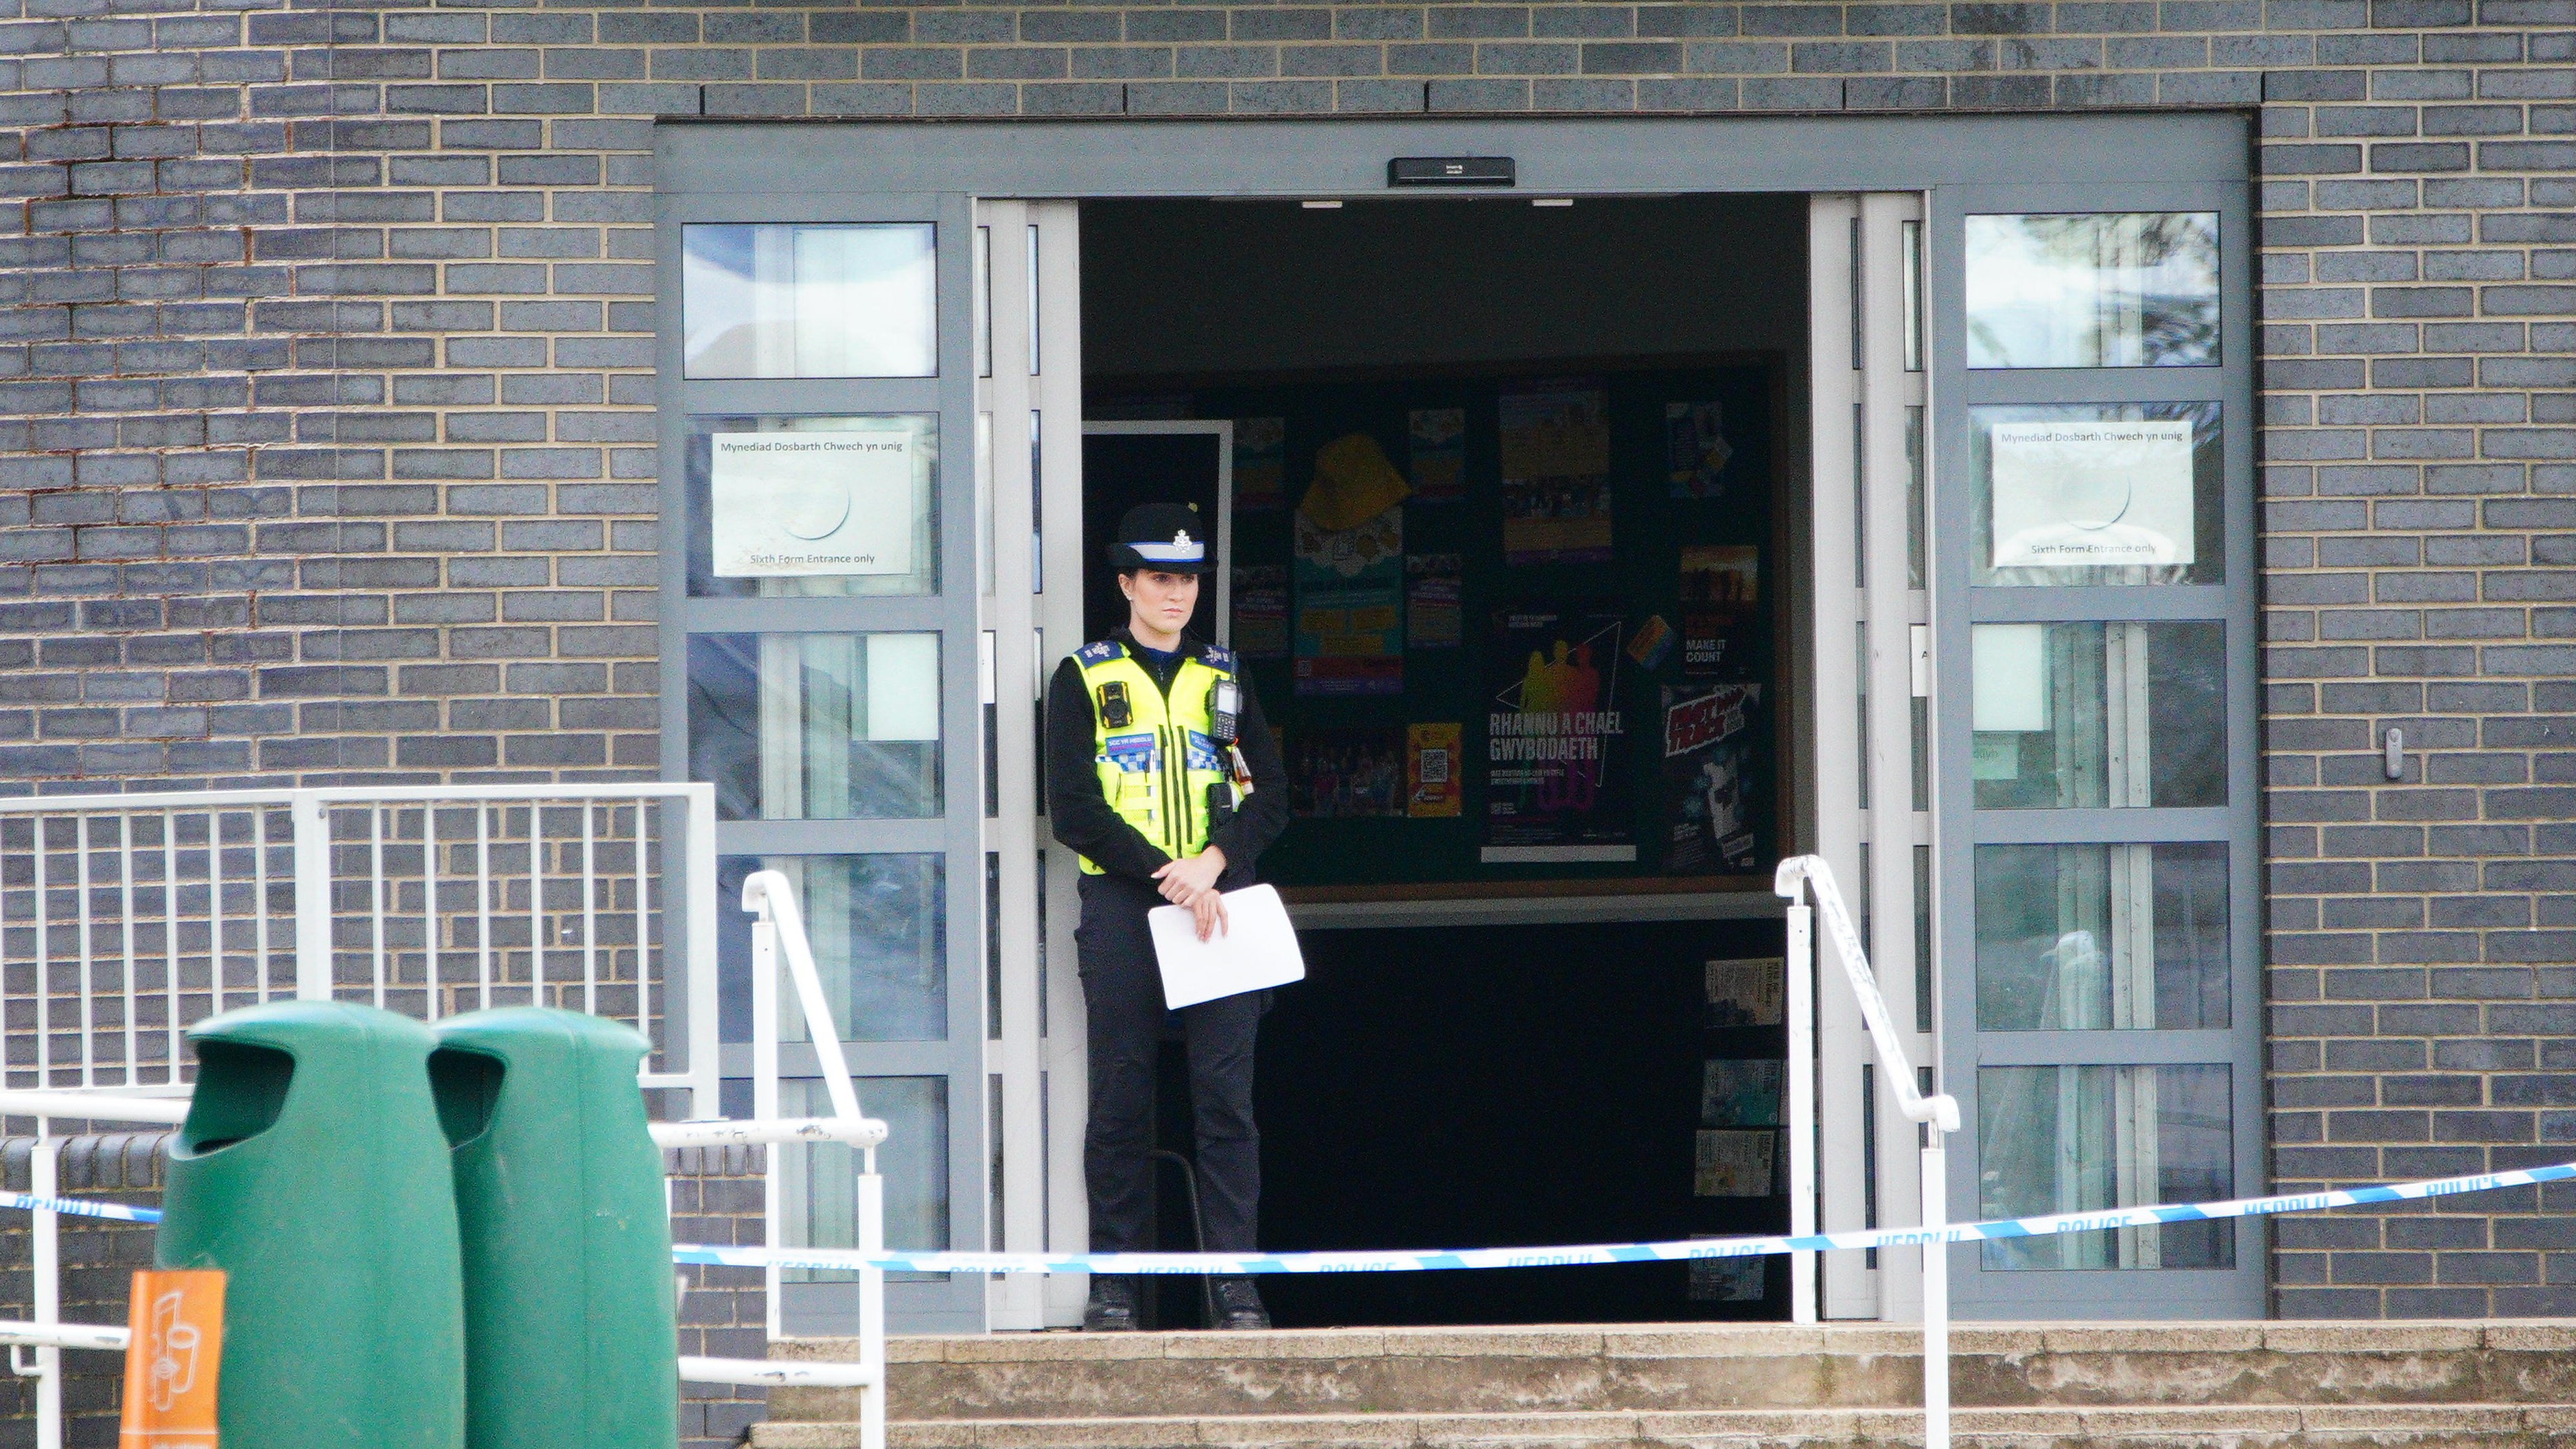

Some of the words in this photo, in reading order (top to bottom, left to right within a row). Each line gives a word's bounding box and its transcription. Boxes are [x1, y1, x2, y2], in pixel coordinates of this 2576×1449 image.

[2001, 433, 2052, 443] Mynediad
[2055, 432, 2101, 442] Dosbarth
[2104, 431, 2143, 441] Chwech
[2146, 434, 2159, 443] yn
[2161, 432, 2183, 443] unig
[721, 442, 771, 453] Mynediad
[775, 441, 821, 452] Dosbarth
[824, 441, 863, 451] Chwech
[866, 443, 879, 452] yn
[881, 441, 903, 452] unig
[2031, 544, 2056, 554] Sixth
[2059, 544, 2085, 554] Form
[2088, 544, 2131, 554] Entrance
[2135, 544, 2156, 555] only
[750, 554, 776, 564] Sixth
[778, 554, 804, 564] Form
[807, 554, 851, 564] Entrance
[854, 553, 875, 565] only
[1686, 639, 1713, 650] MAKE
[1717, 638, 1727, 650] IT
[1686, 651, 1721, 663] COUNT
[1489, 712, 1557, 736] RHANNU
[1561, 712, 1572, 735] A
[1575, 711, 1624, 734] CHAEL
[1489, 737, 1598, 761] GWYBODAETH
